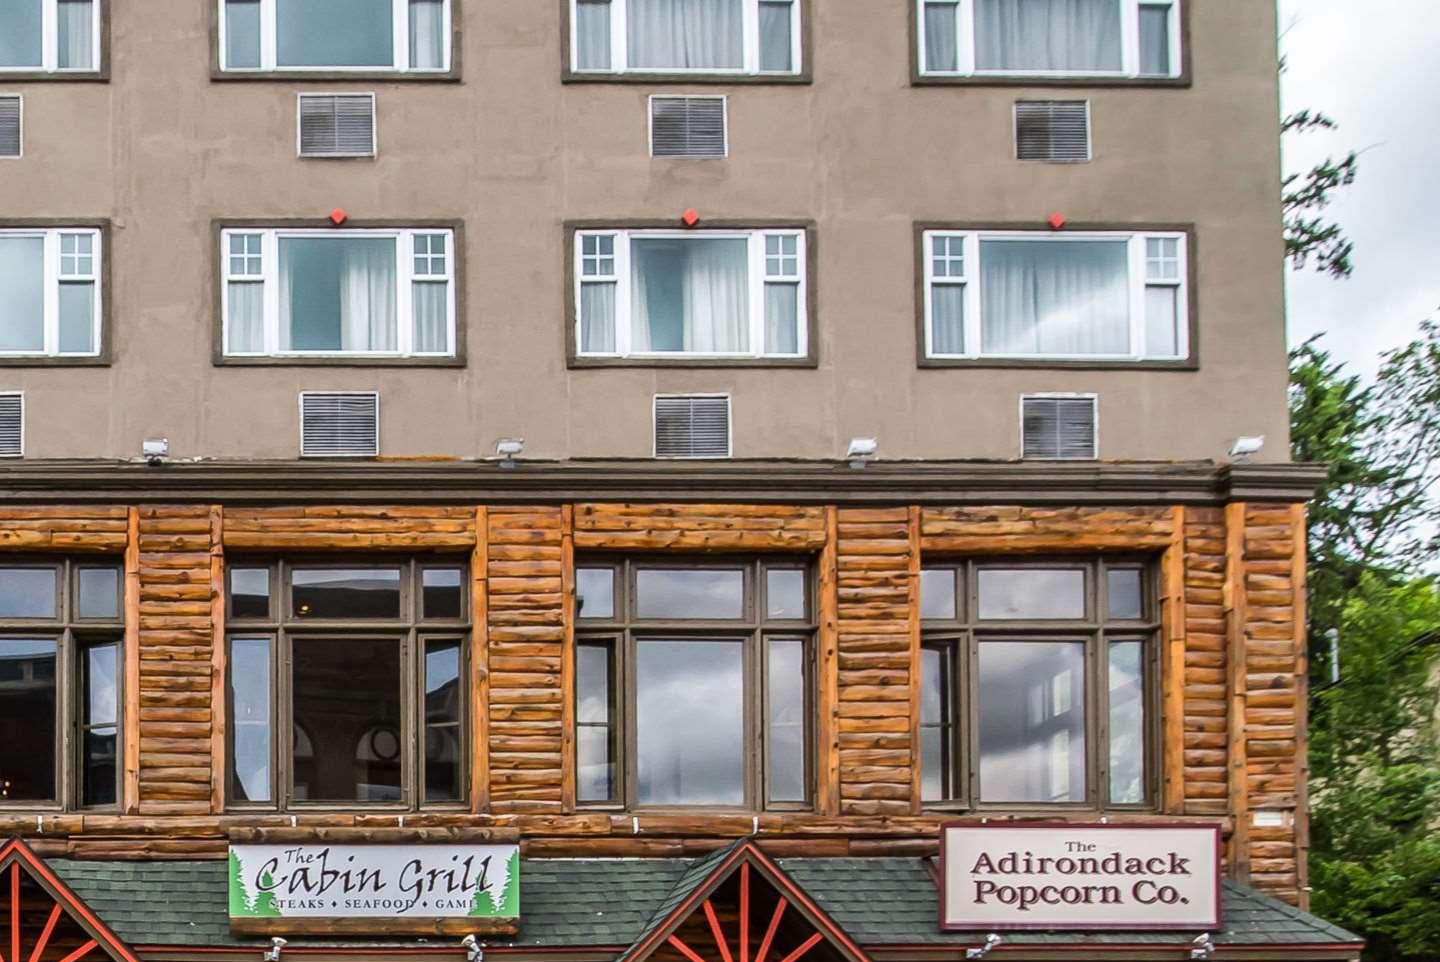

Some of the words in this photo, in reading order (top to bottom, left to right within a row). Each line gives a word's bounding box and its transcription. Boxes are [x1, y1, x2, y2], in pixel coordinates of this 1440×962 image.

[285, 848, 316, 864] The
[1064, 841, 1096, 852] The
[970, 852, 1191, 875] Adirondack
[255, 848, 386, 897] Cabin
[399, 855, 494, 914] Grill
[269, 899, 324, 909] STEAKS
[344, 899, 415, 909] SEAFOOD
[972, 880, 1125, 911] Popcorn
[1132, 880, 1190, 905] Co.
